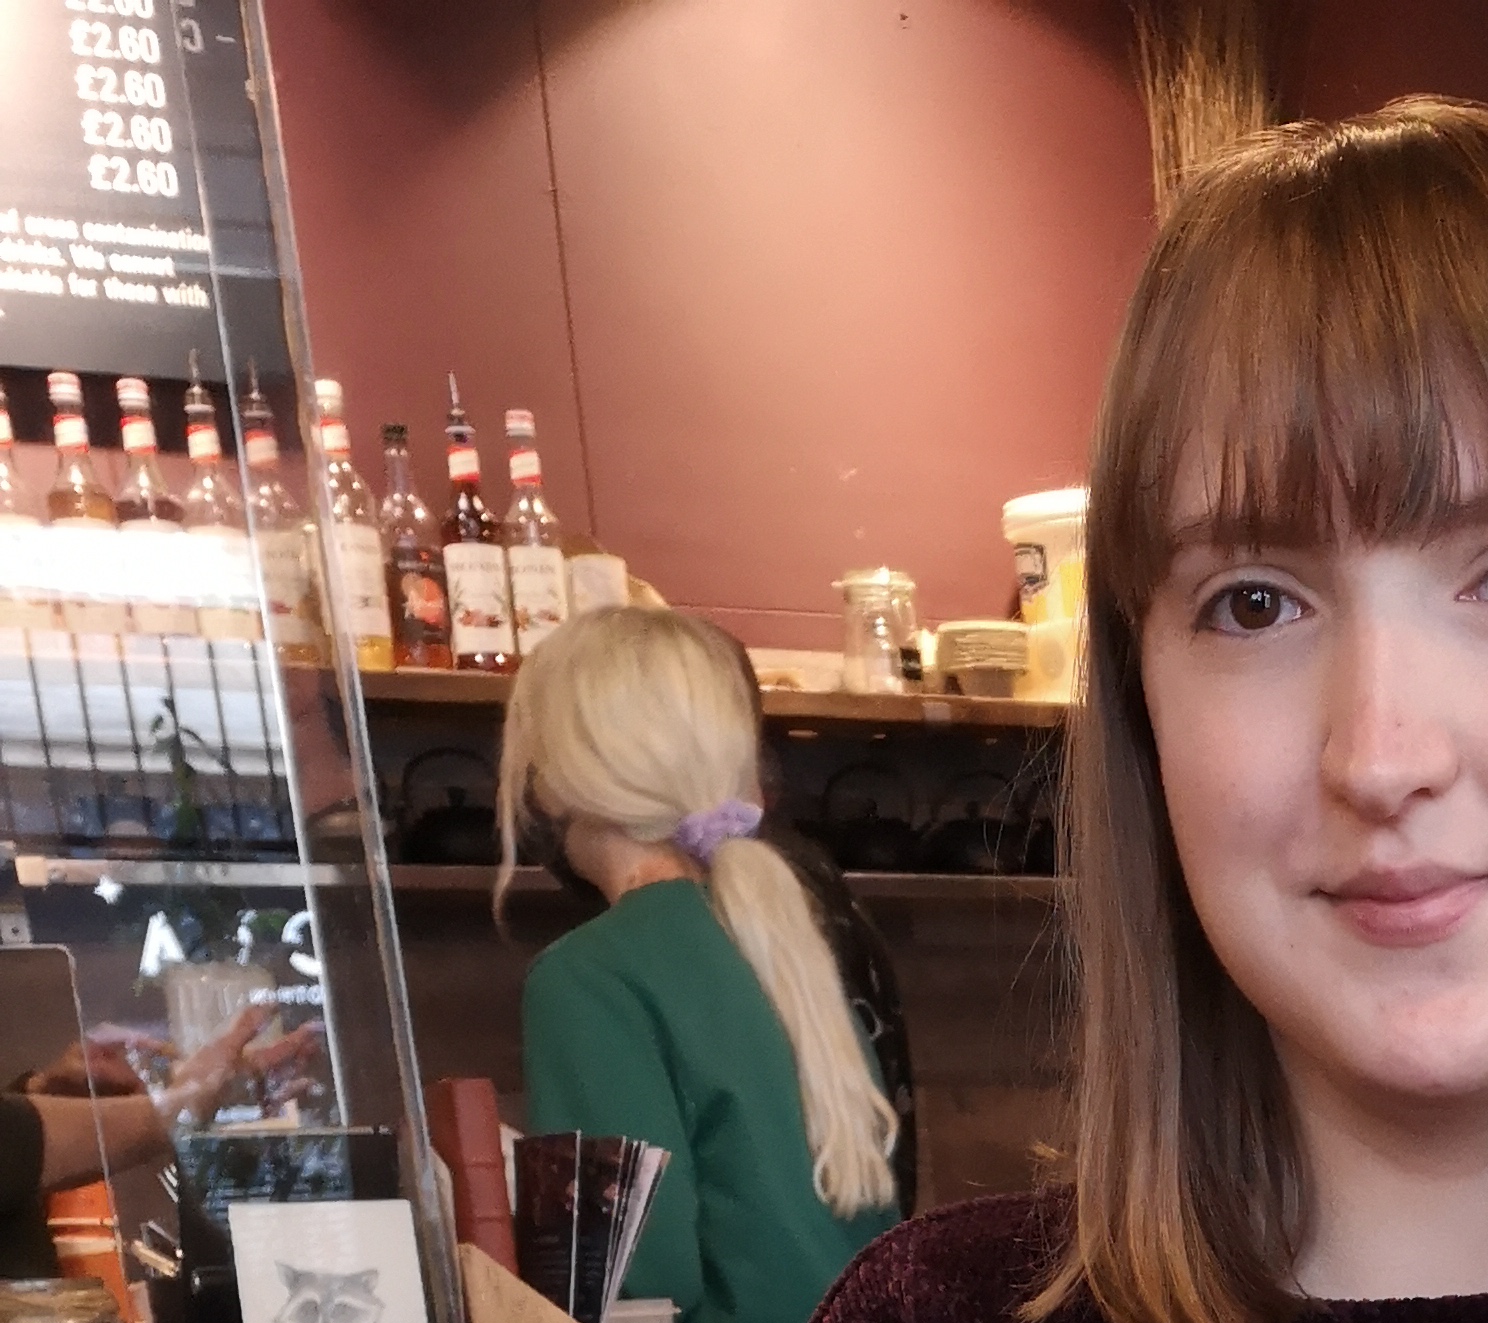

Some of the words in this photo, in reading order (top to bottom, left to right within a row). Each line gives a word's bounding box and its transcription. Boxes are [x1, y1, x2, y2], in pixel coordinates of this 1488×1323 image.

[68, 18, 160, 64] £2.60
[74, 63, 166, 108] £2.60
[81, 108, 173, 153] £2.60
[87, 153, 179, 197] £2.60
